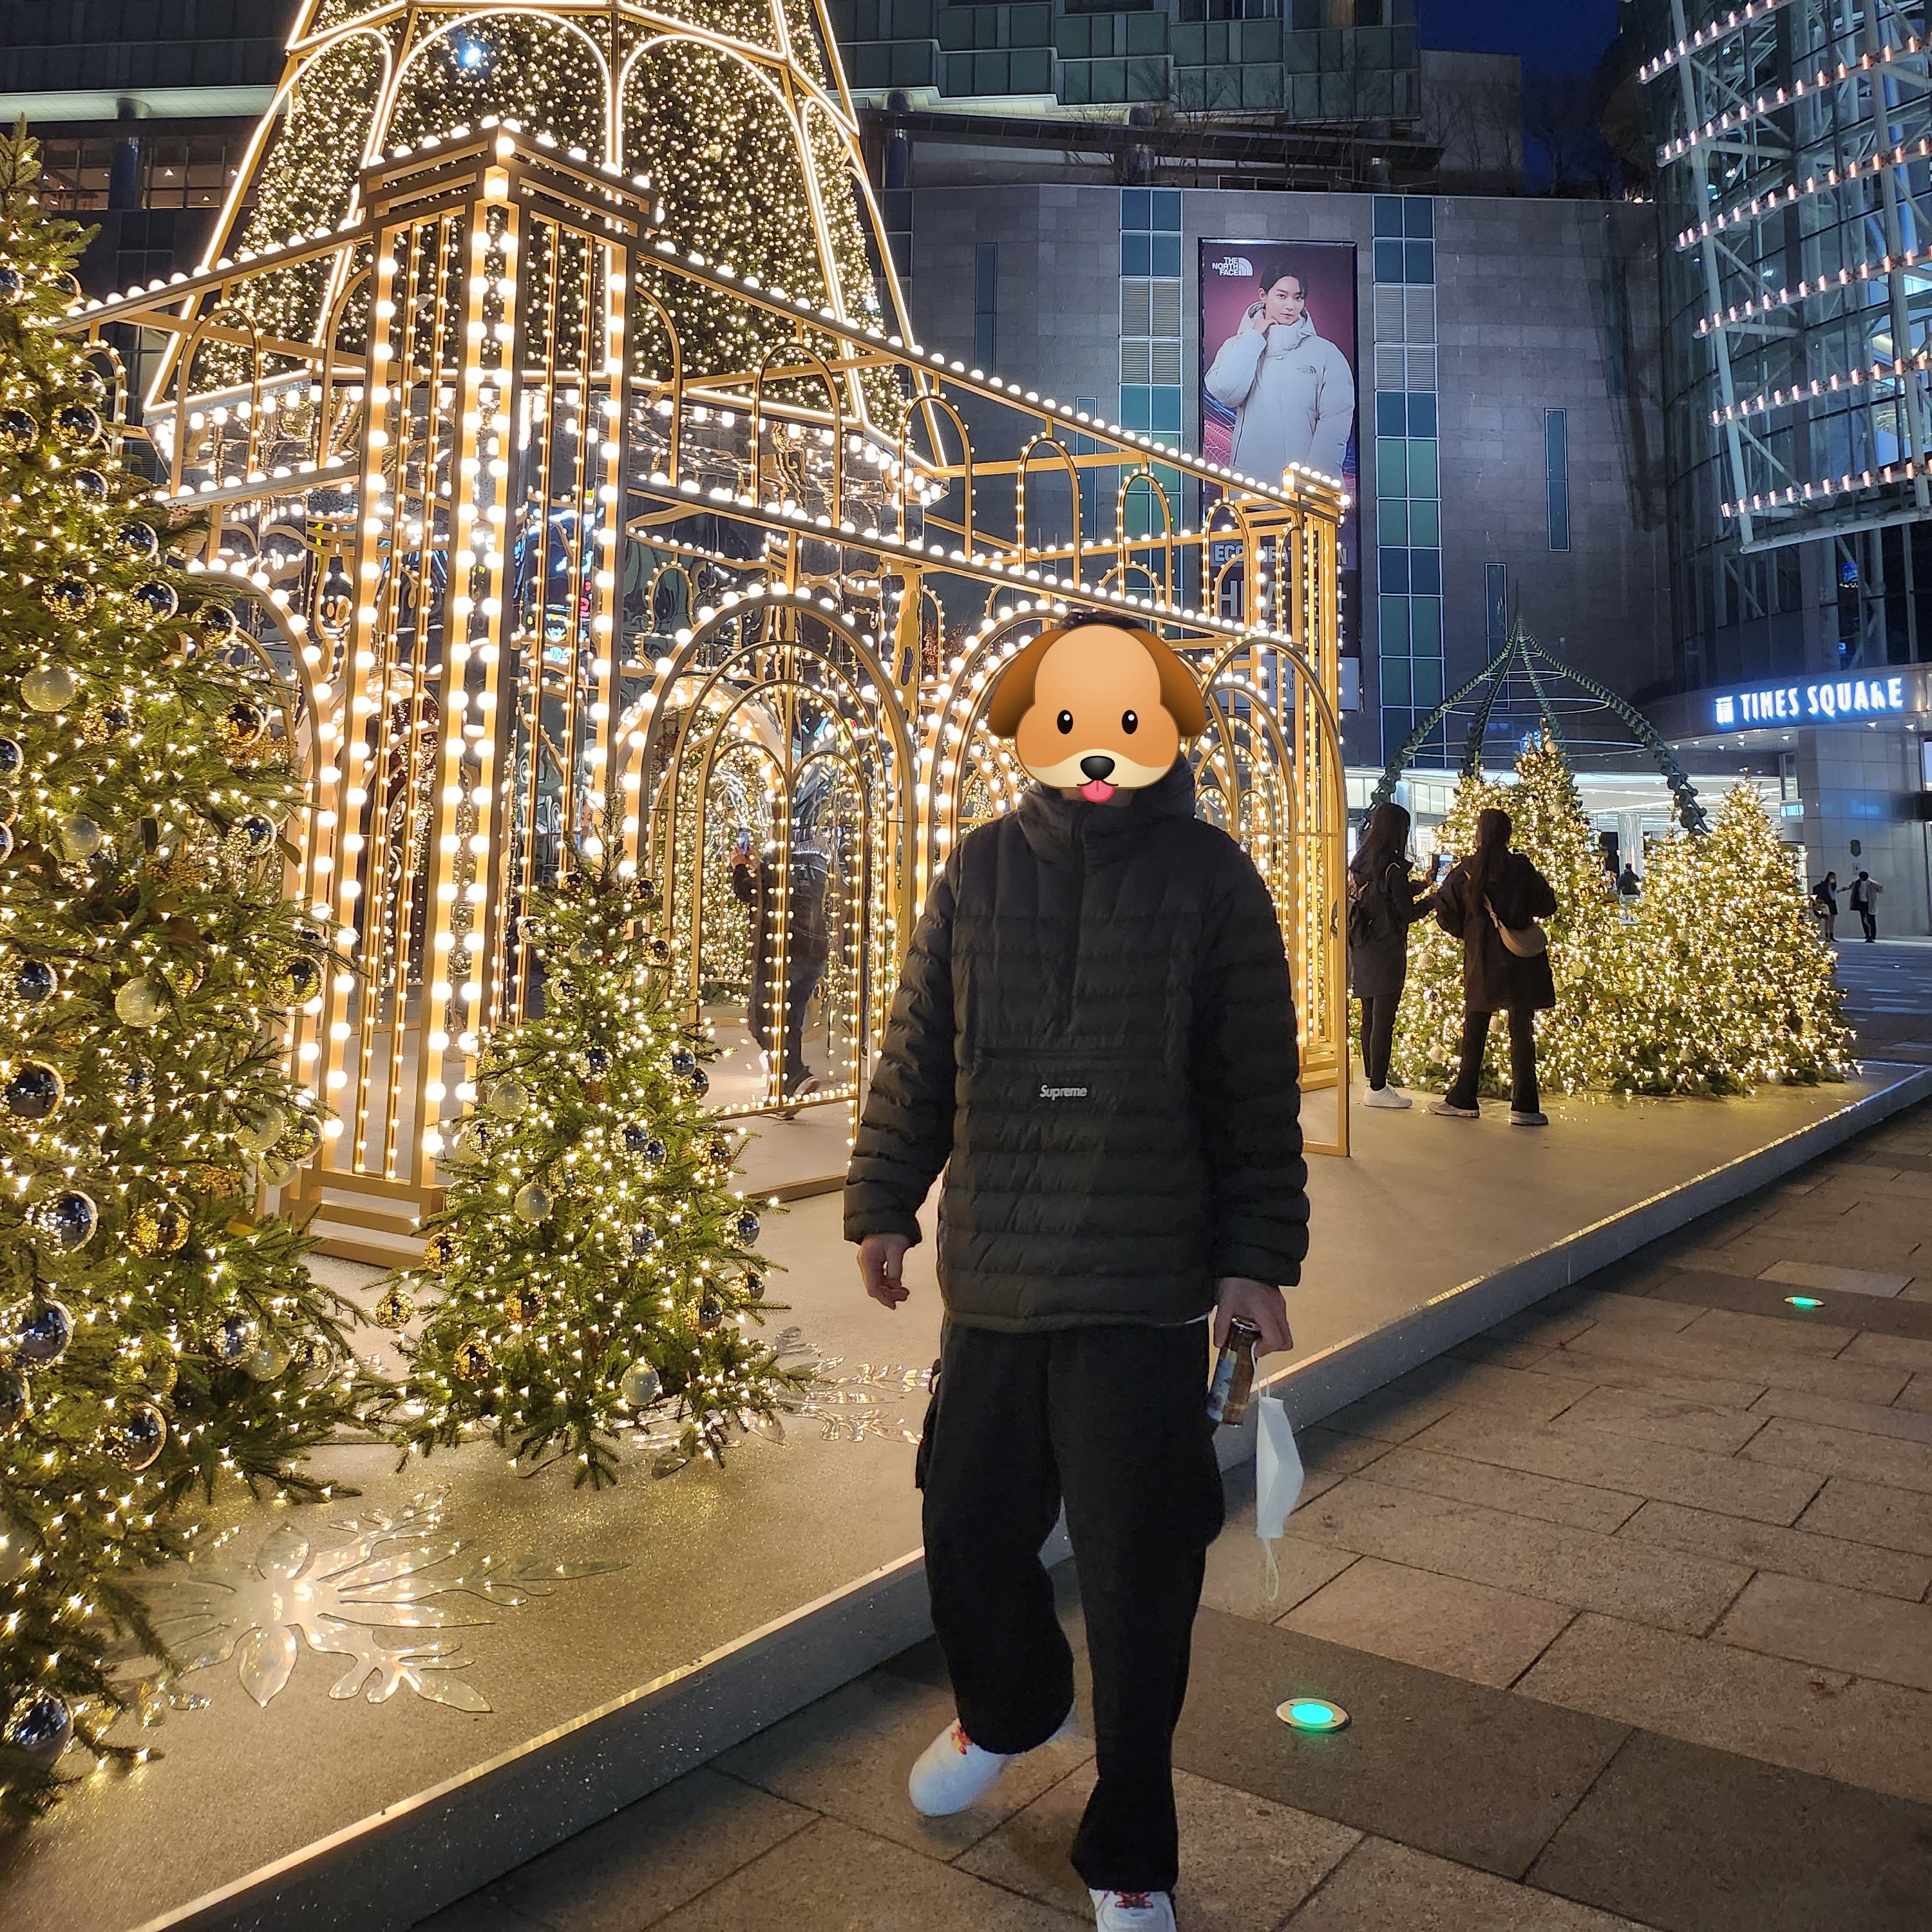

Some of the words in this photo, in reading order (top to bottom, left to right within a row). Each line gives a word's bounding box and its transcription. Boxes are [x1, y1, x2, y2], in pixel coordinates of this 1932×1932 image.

[1739, 687, 1799, 721] TIMES
[1807, 677, 1903, 717] SQUARE
[1039, 1084, 1088, 1101] Supreme
